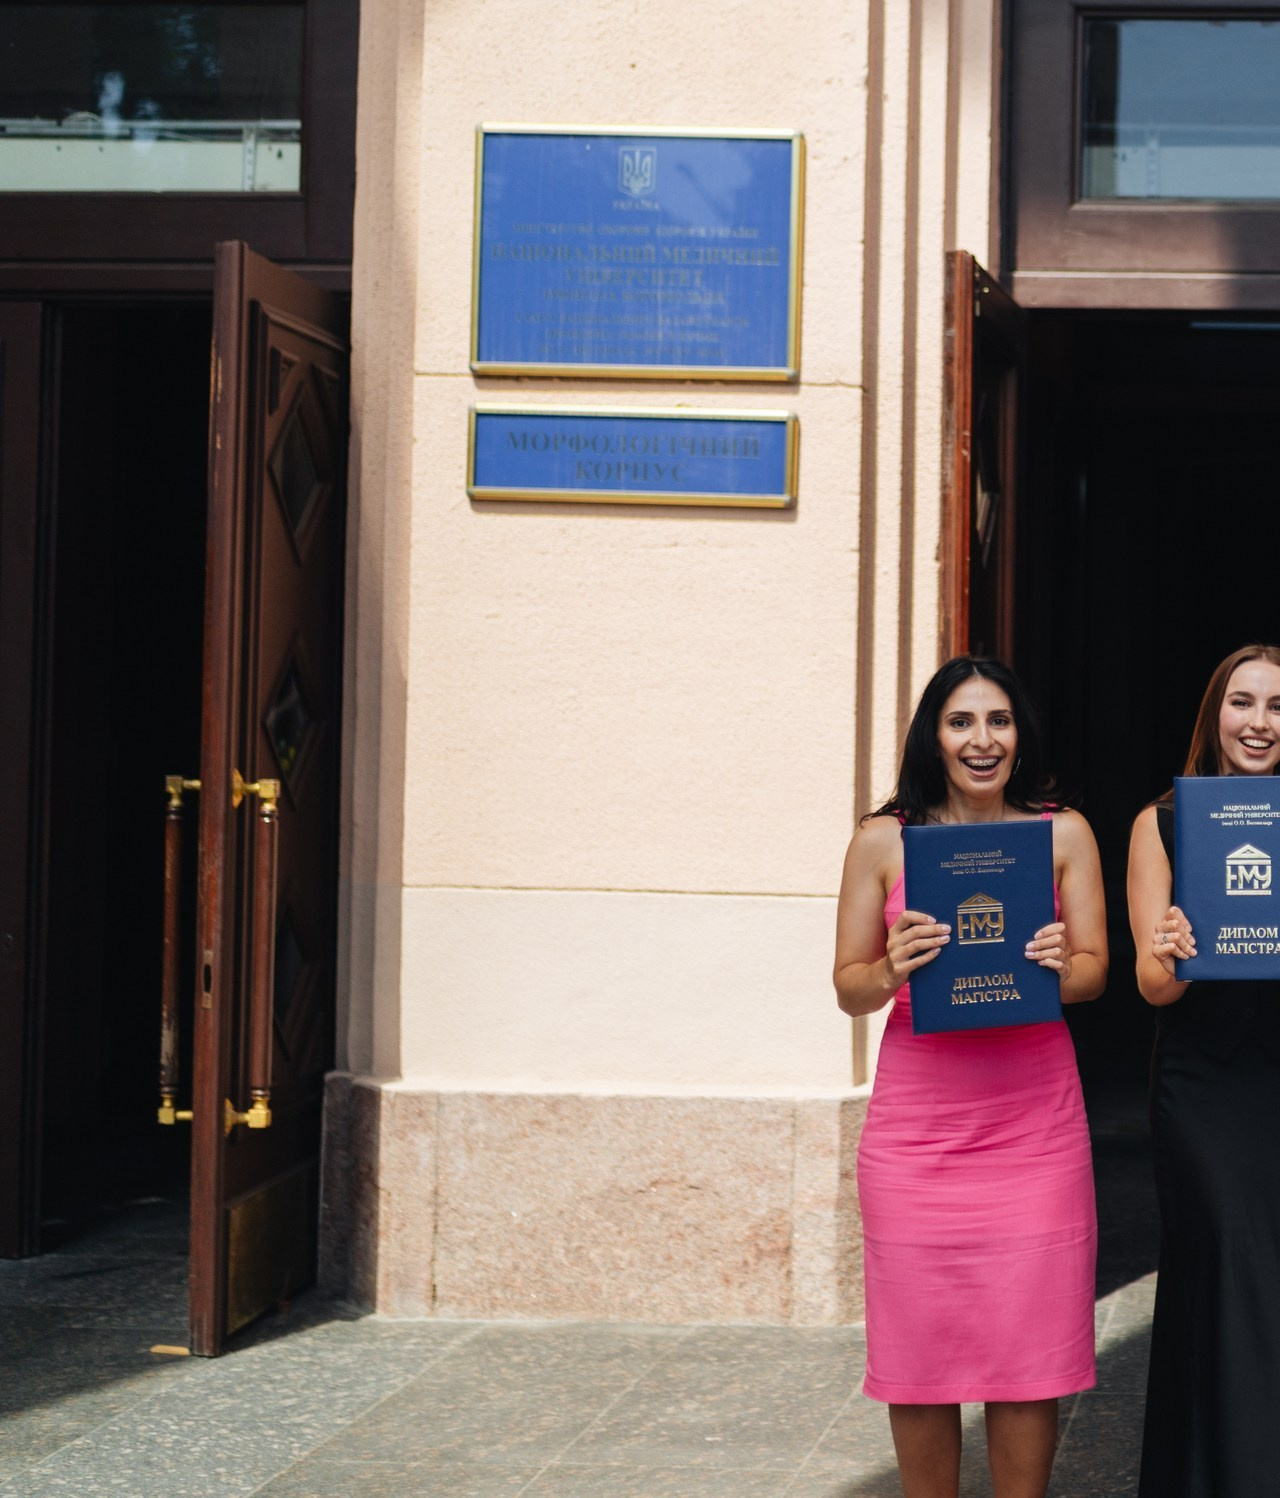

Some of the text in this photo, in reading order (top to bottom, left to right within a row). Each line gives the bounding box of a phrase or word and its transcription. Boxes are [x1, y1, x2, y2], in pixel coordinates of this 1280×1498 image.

[506, 431, 760, 459] МОРФОЛОГІЧНИЙ
[576, 460, 689, 483] КОРПУС
[1210, 811, 1244, 819] МЕДИЧНИЙ
[1223, 803, 1271, 812] НАЦІОНАЛЬНИЙ
[1217, 927, 1278, 941] ДИПЛОМ
[953, 973, 1014, 991] ДИПЛОМ
[951, 989, 1021, 1005] МАГІСТРА
